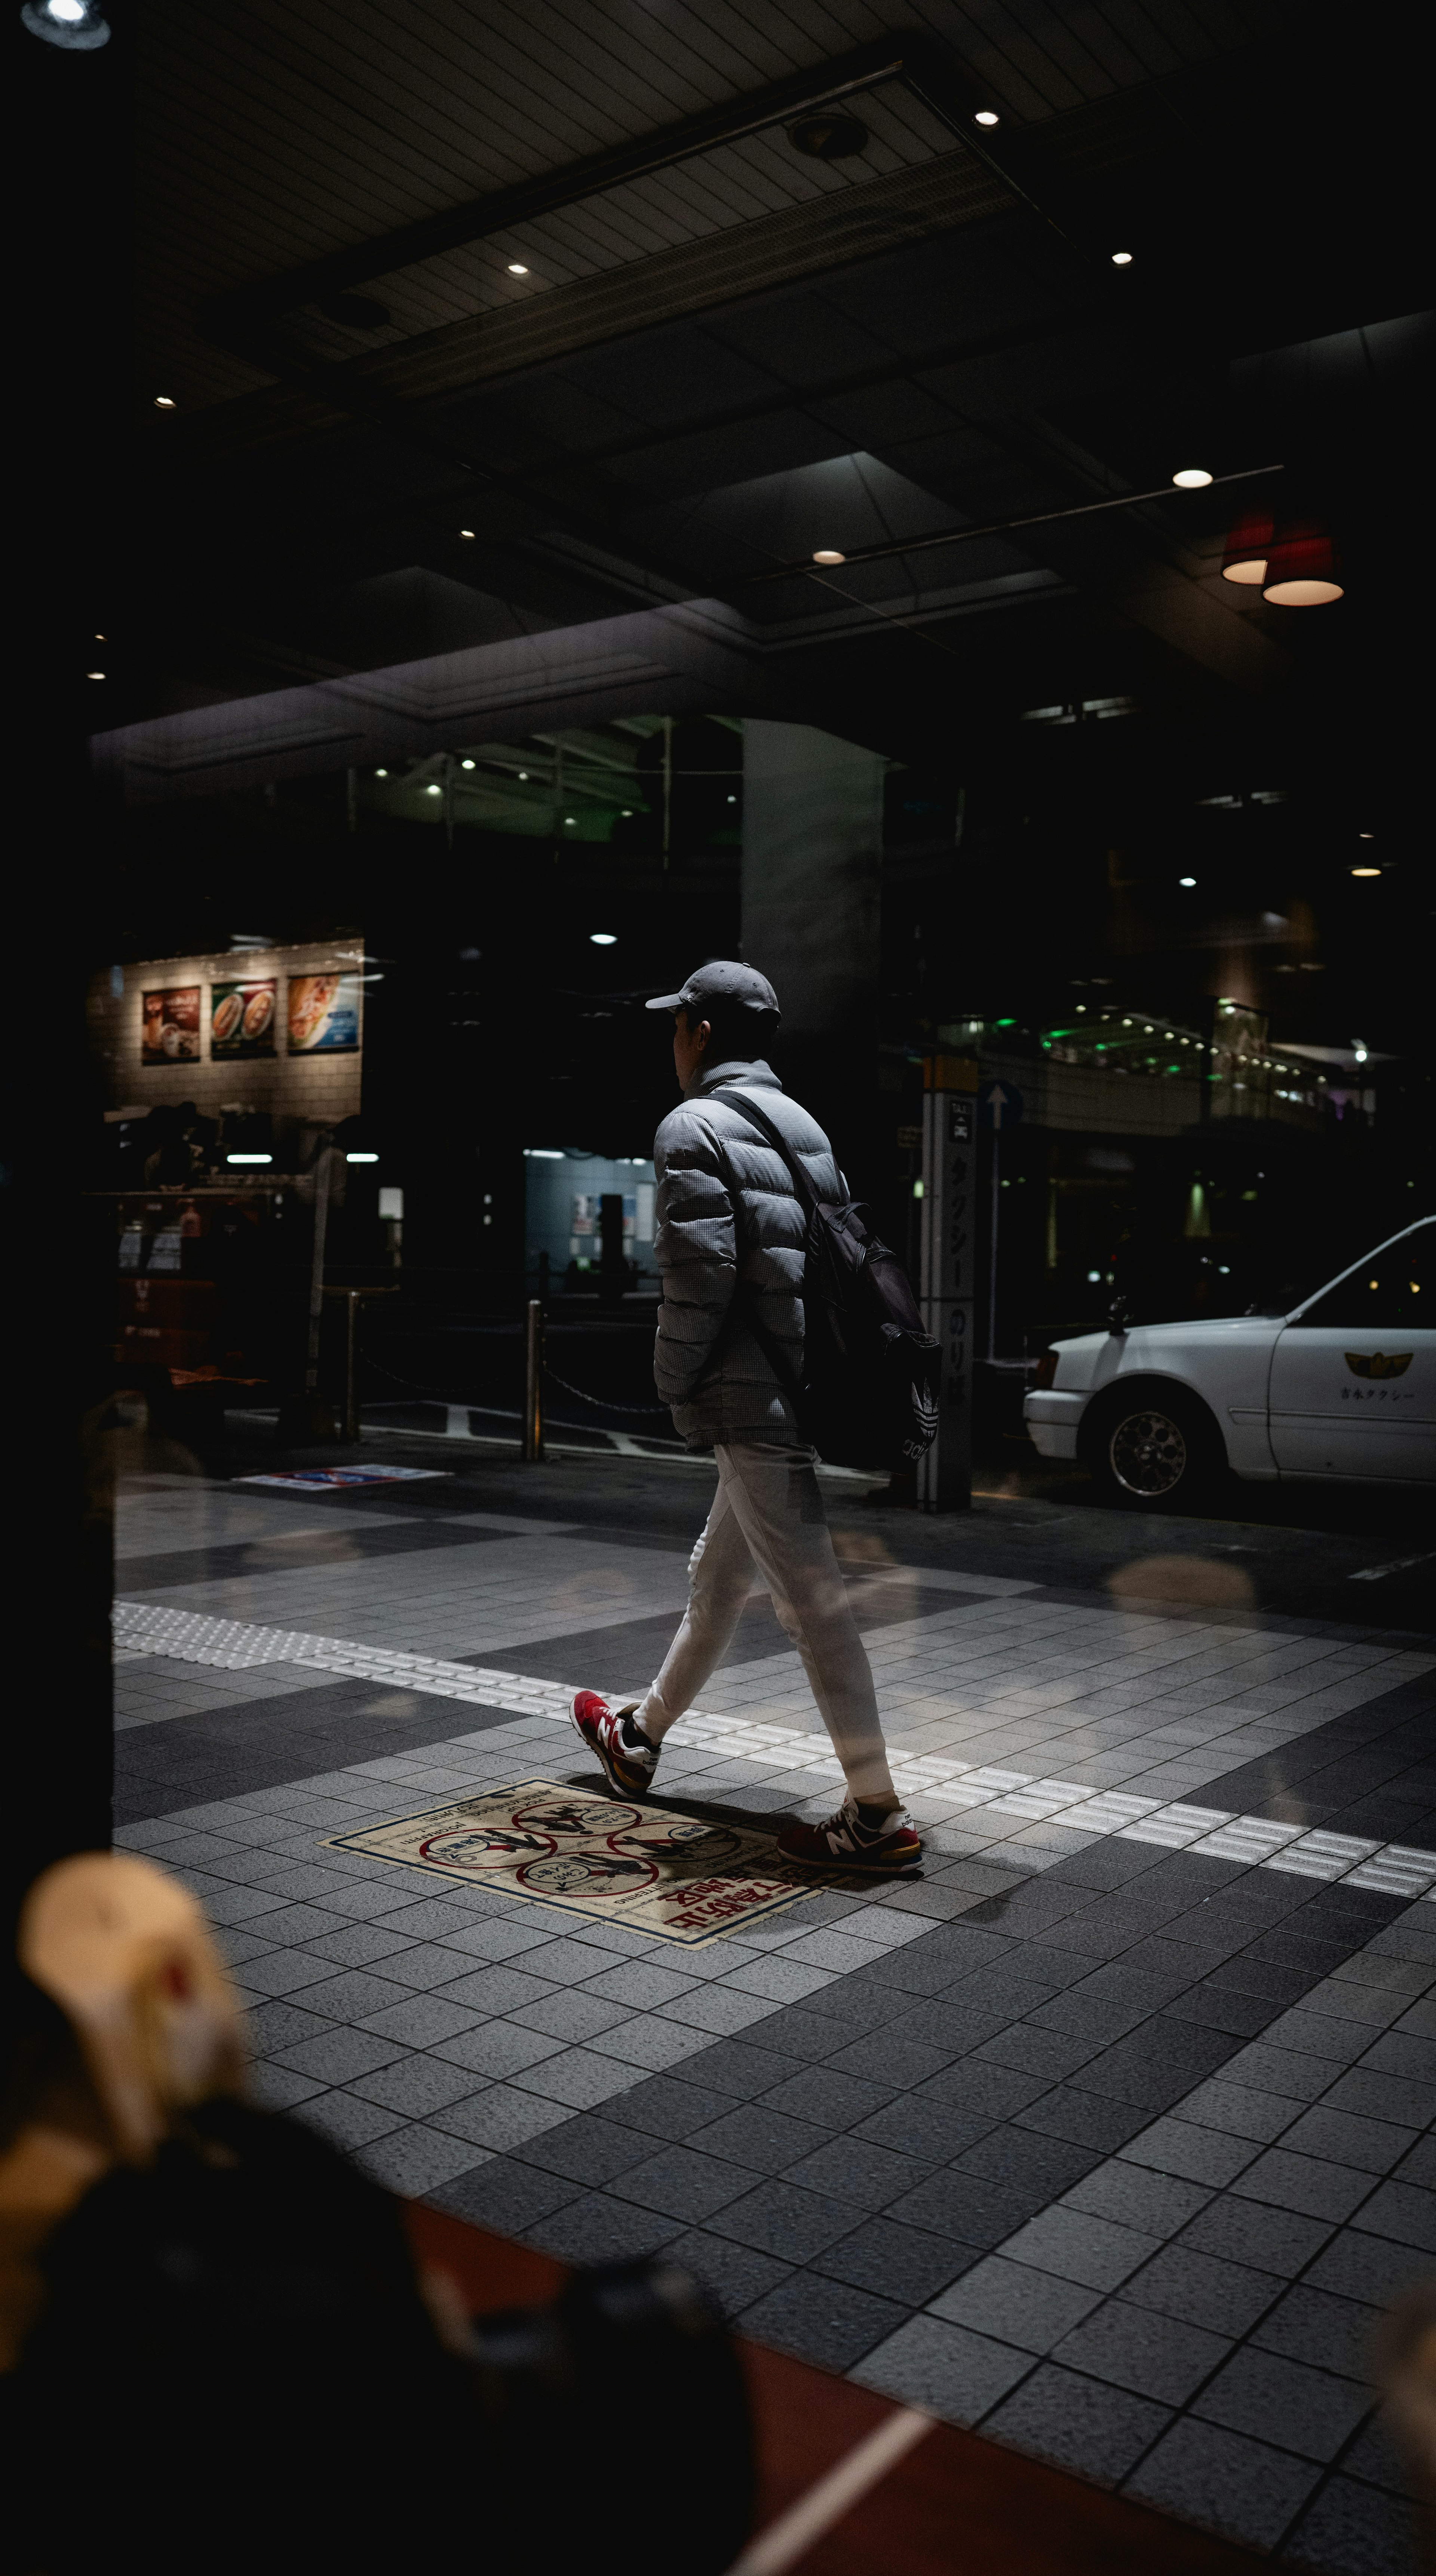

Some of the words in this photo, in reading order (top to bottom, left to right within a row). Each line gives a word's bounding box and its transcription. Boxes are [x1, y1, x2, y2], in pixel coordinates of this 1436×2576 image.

[902, 1439, 931, 1460] adi
[421, 1804, 481, 1821] 北九州市
[471, 1808, 494, 1816] DOG
[400, 1829, 449, 1844] GRAFFITI
[826, 1828, 856, 1855] N
[436, 1839, 479, 1853] 落書き
[705, 1851, 750, 1868] SMOKING
[530, 1863, 571, 1878] ポイ捨て
[553, 1869, 585, 1880] ごみの
[657, 1856, 785, 1907] 重点地区
[613, 1883, 668, 1904] LITTERING
